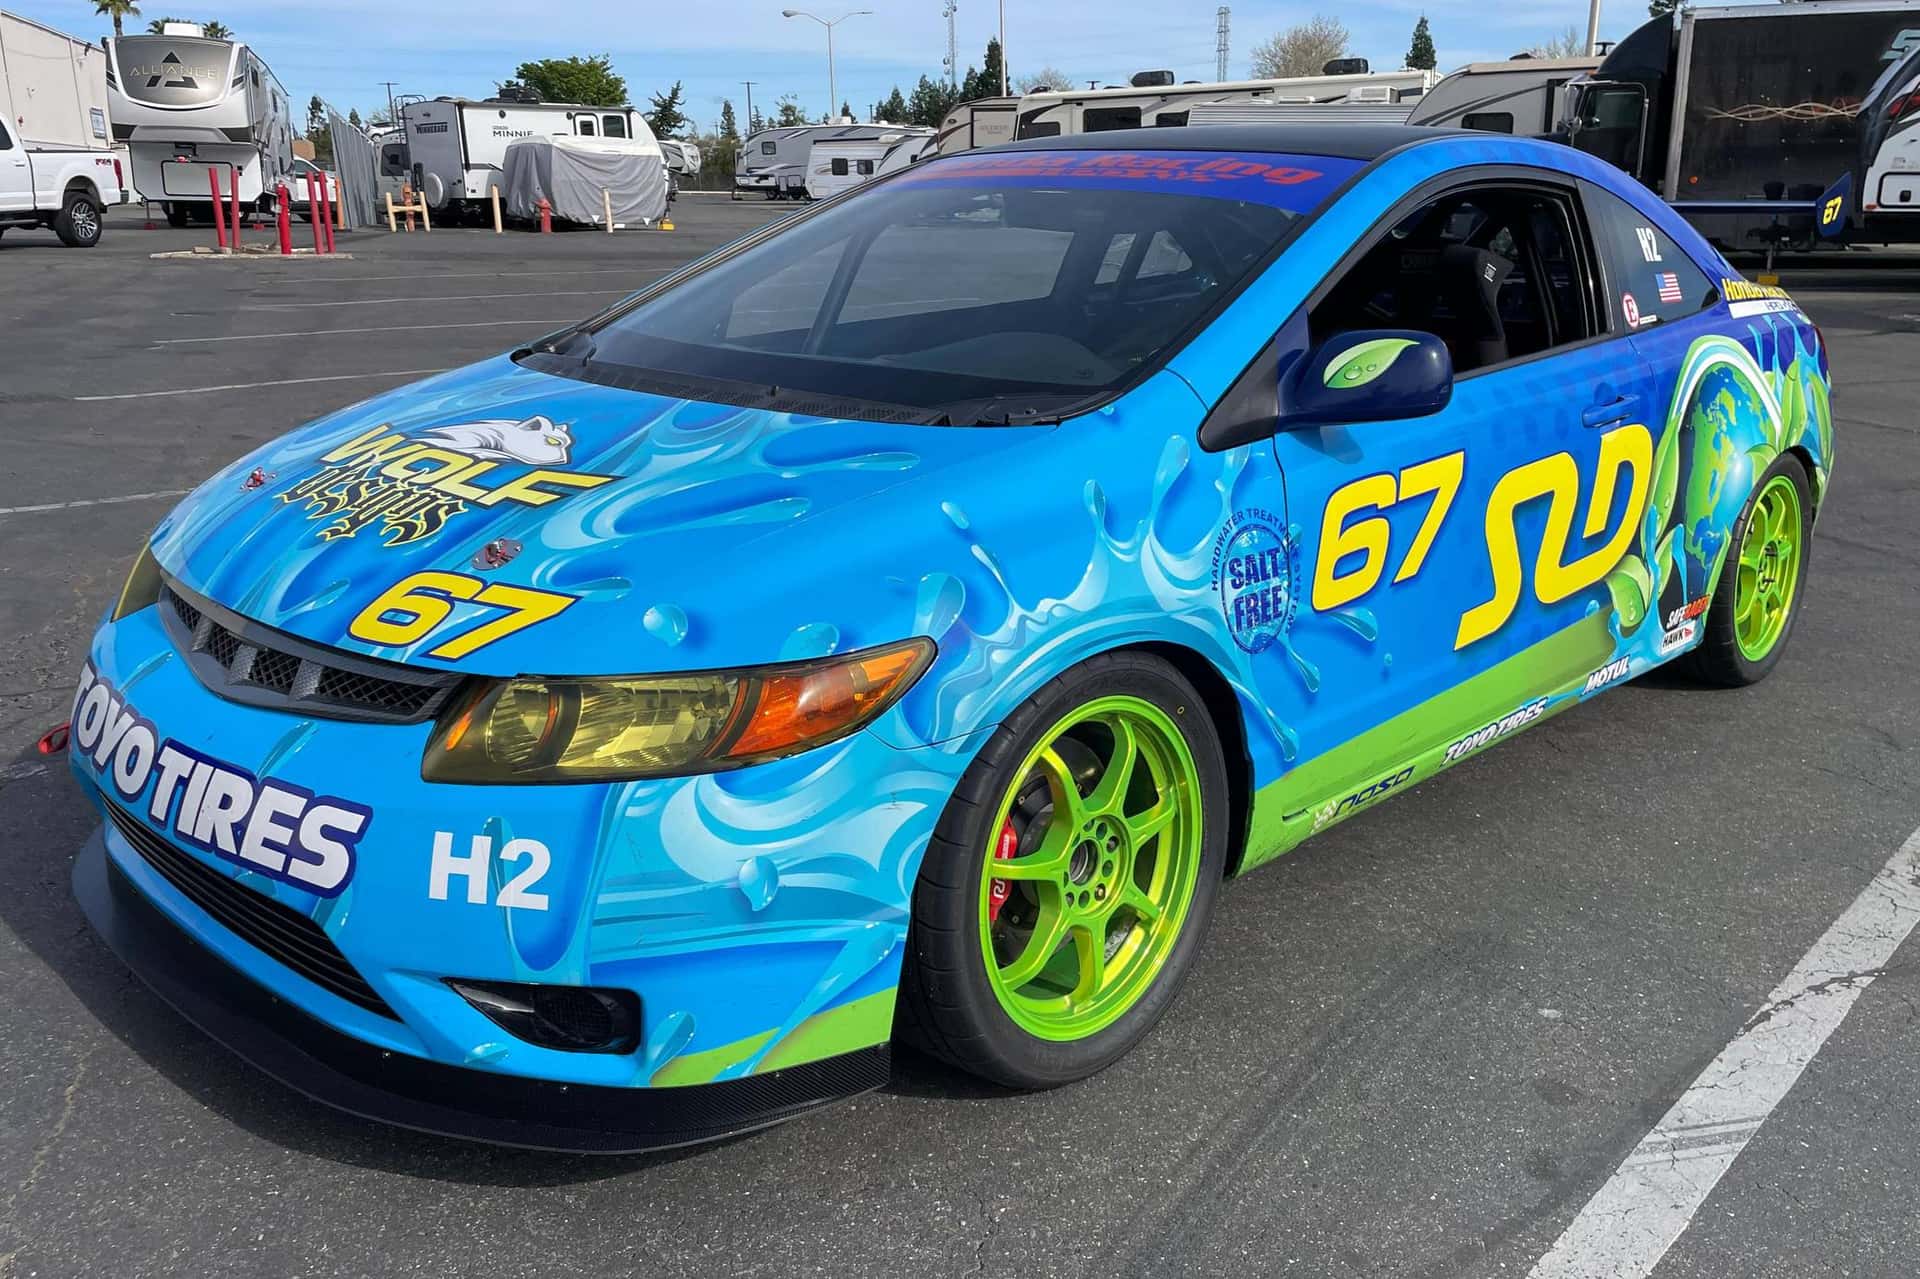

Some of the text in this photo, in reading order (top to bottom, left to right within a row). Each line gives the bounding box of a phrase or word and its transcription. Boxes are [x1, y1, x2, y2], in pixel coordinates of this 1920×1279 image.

[129, 63, 218, 79] ALLIANCE
[1822, 195, 1843, 225] 67
[1636, 227, 1662, 262] H2
[320, 423, 616, 508] WOLF
[1312, 449, 1465, 611] 67
[1228, 546, 1281, 590] SALT
[346, 570, 583, 663] 67
[1234, 584, 1283, 632] FREE
[1662, 627, 1685, 649] HAWK
[1582, 655, 1630, 696] MOTUL
[1441, 697, 1549, 767] TOYO TIRES
[68, 663, 366, 890] TOYO TIRES
[428, 831, 551, 912] H2
